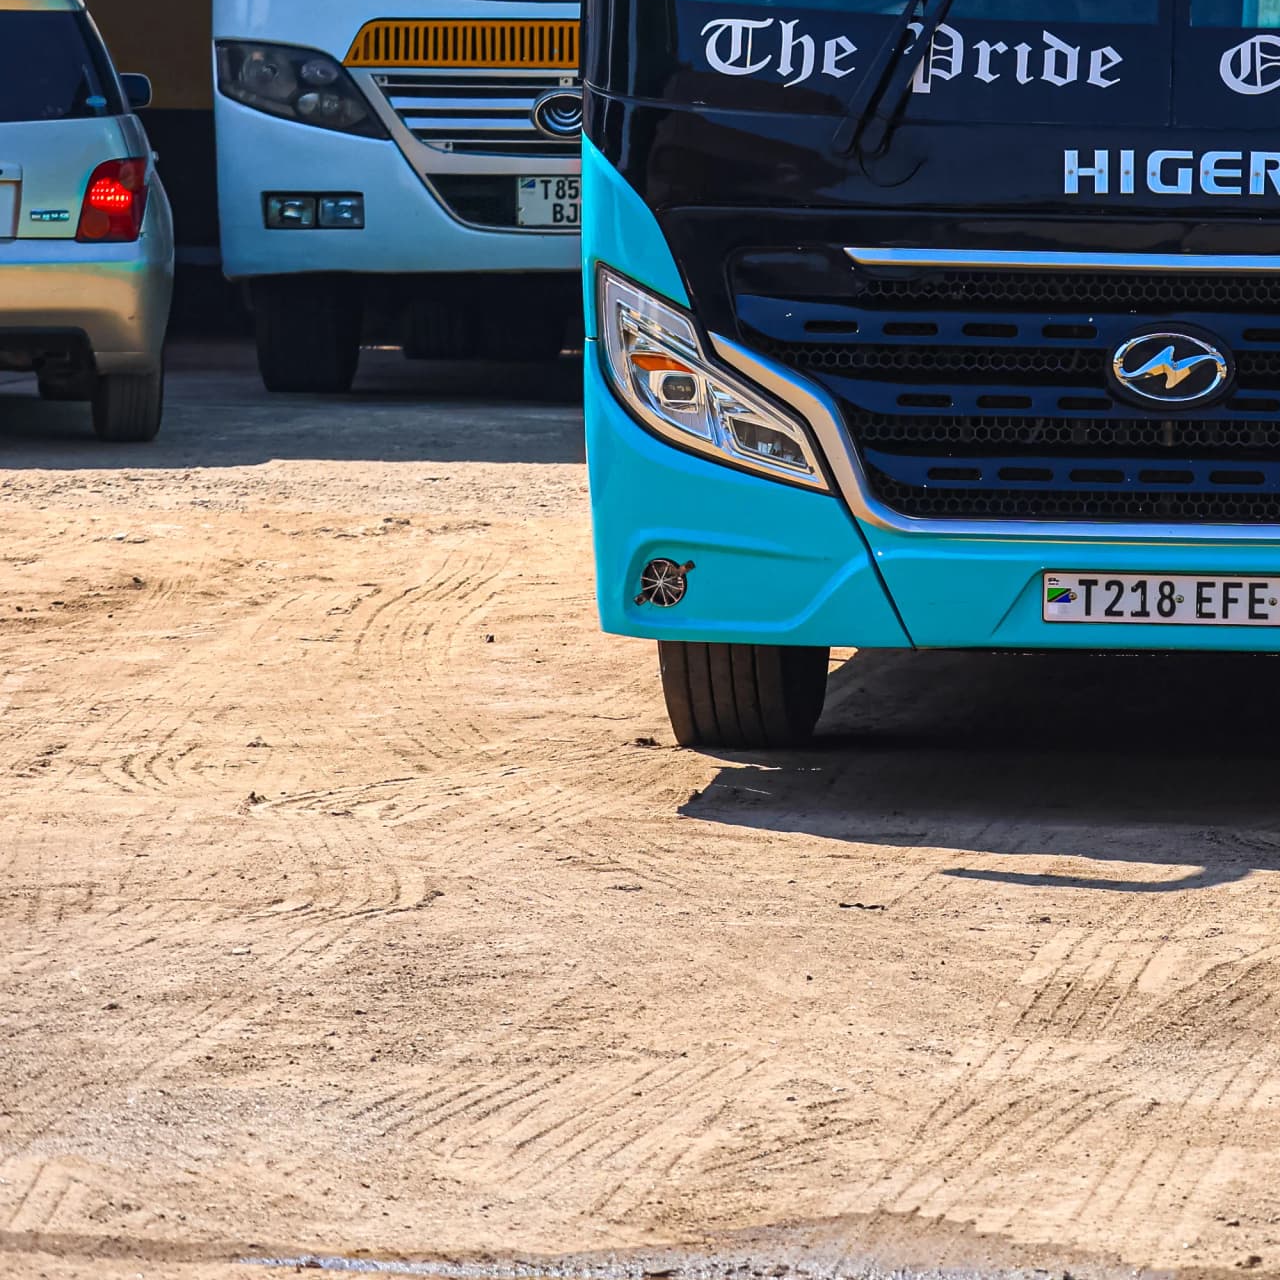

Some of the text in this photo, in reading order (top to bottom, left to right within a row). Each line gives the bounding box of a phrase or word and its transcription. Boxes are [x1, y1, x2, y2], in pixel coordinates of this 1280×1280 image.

[700, 17, 858, 88] The
[1078, 578, 1269, 620] T218 EFE
